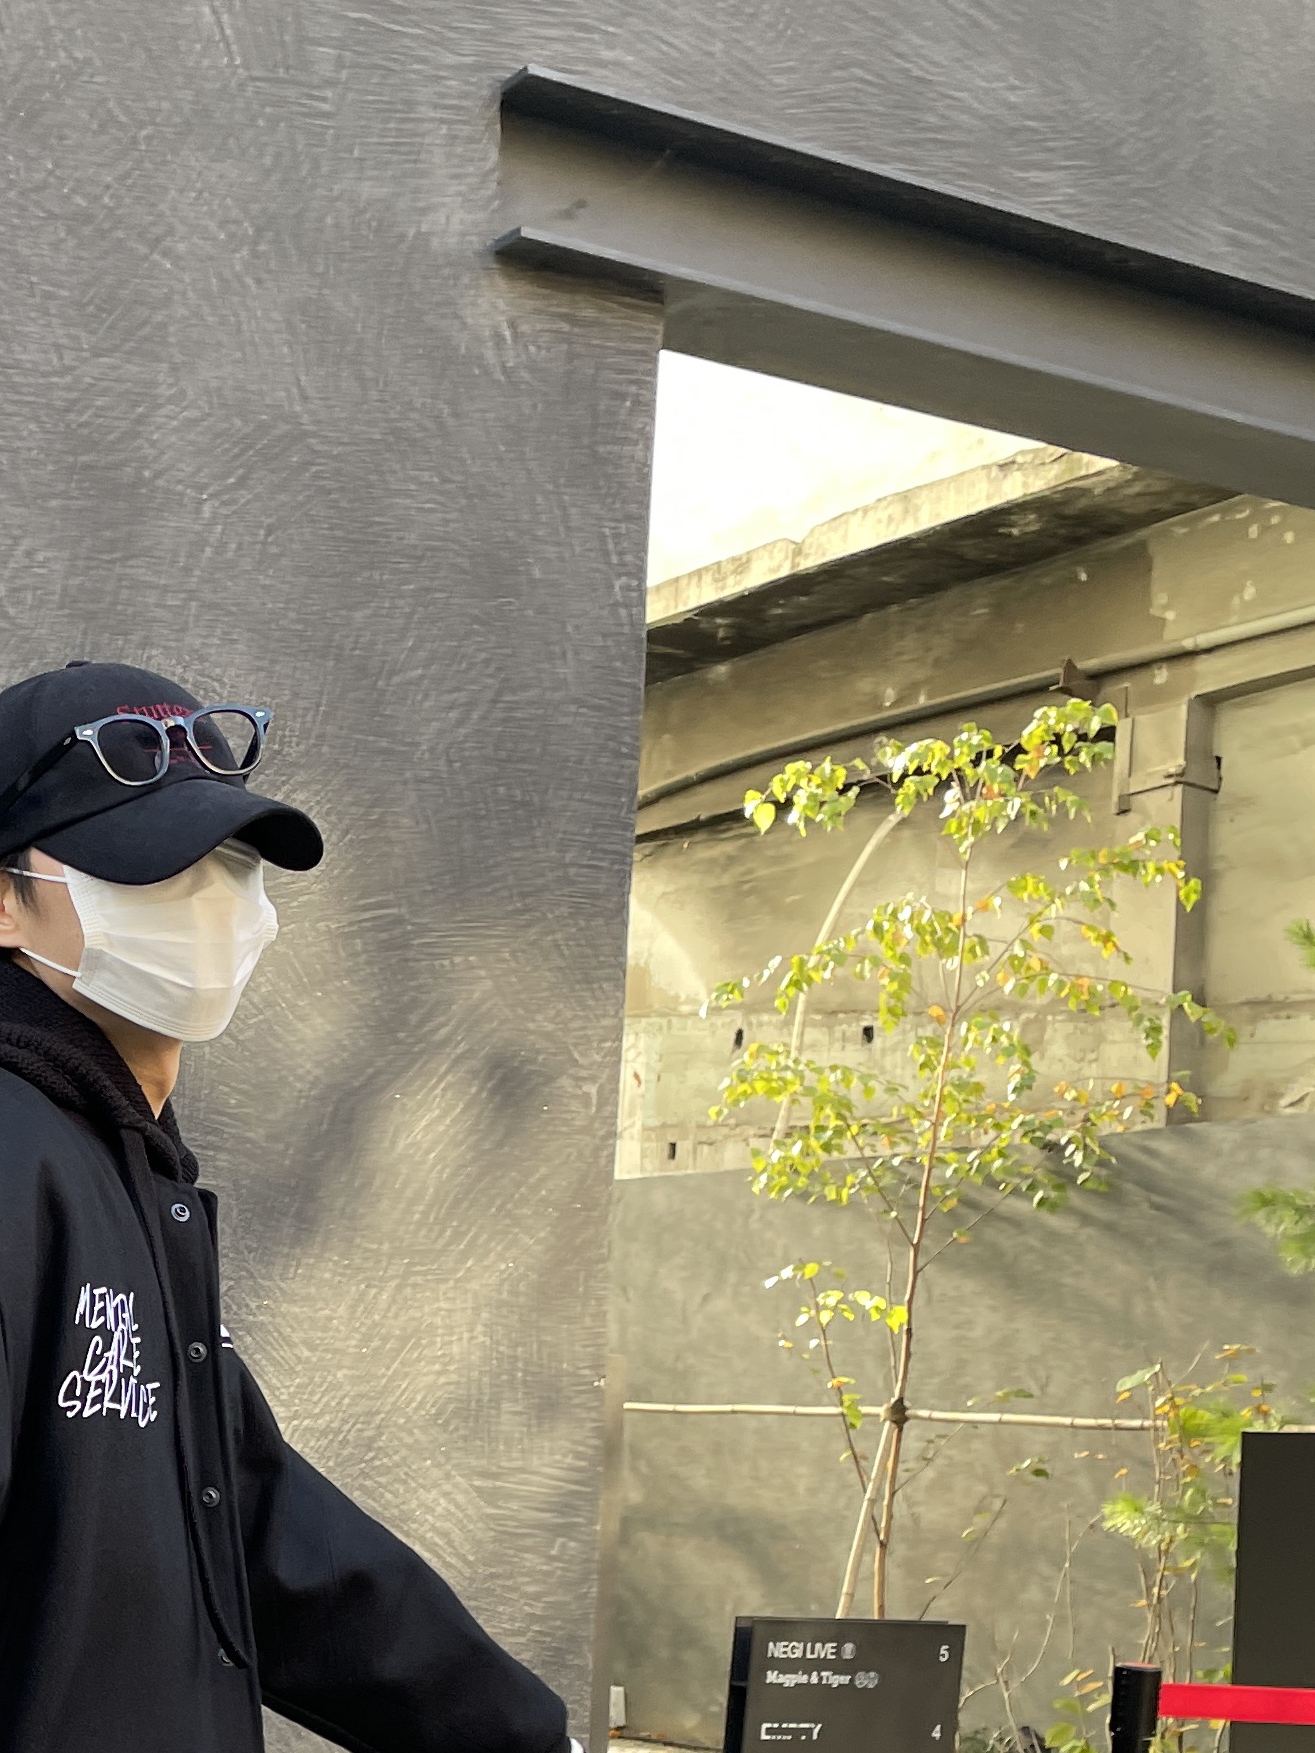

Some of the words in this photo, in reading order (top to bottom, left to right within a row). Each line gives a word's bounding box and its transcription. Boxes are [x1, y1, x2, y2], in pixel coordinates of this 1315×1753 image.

[83, 1325, 141, 1382] CARE
[58, 1370, 161, 1428] SERVICE
[766, 1641, 804, 1659] NEGI
[805, 1642, 838, 1659] LIVE
[939, 1645, 950, 1662] 5
[765, 1669, 809, 1688] Magpie
[810, 1670, 819, 1685] &
[820, 1670, 852, 1688] Tiger
[931, 1724, 942, 1740] 4
